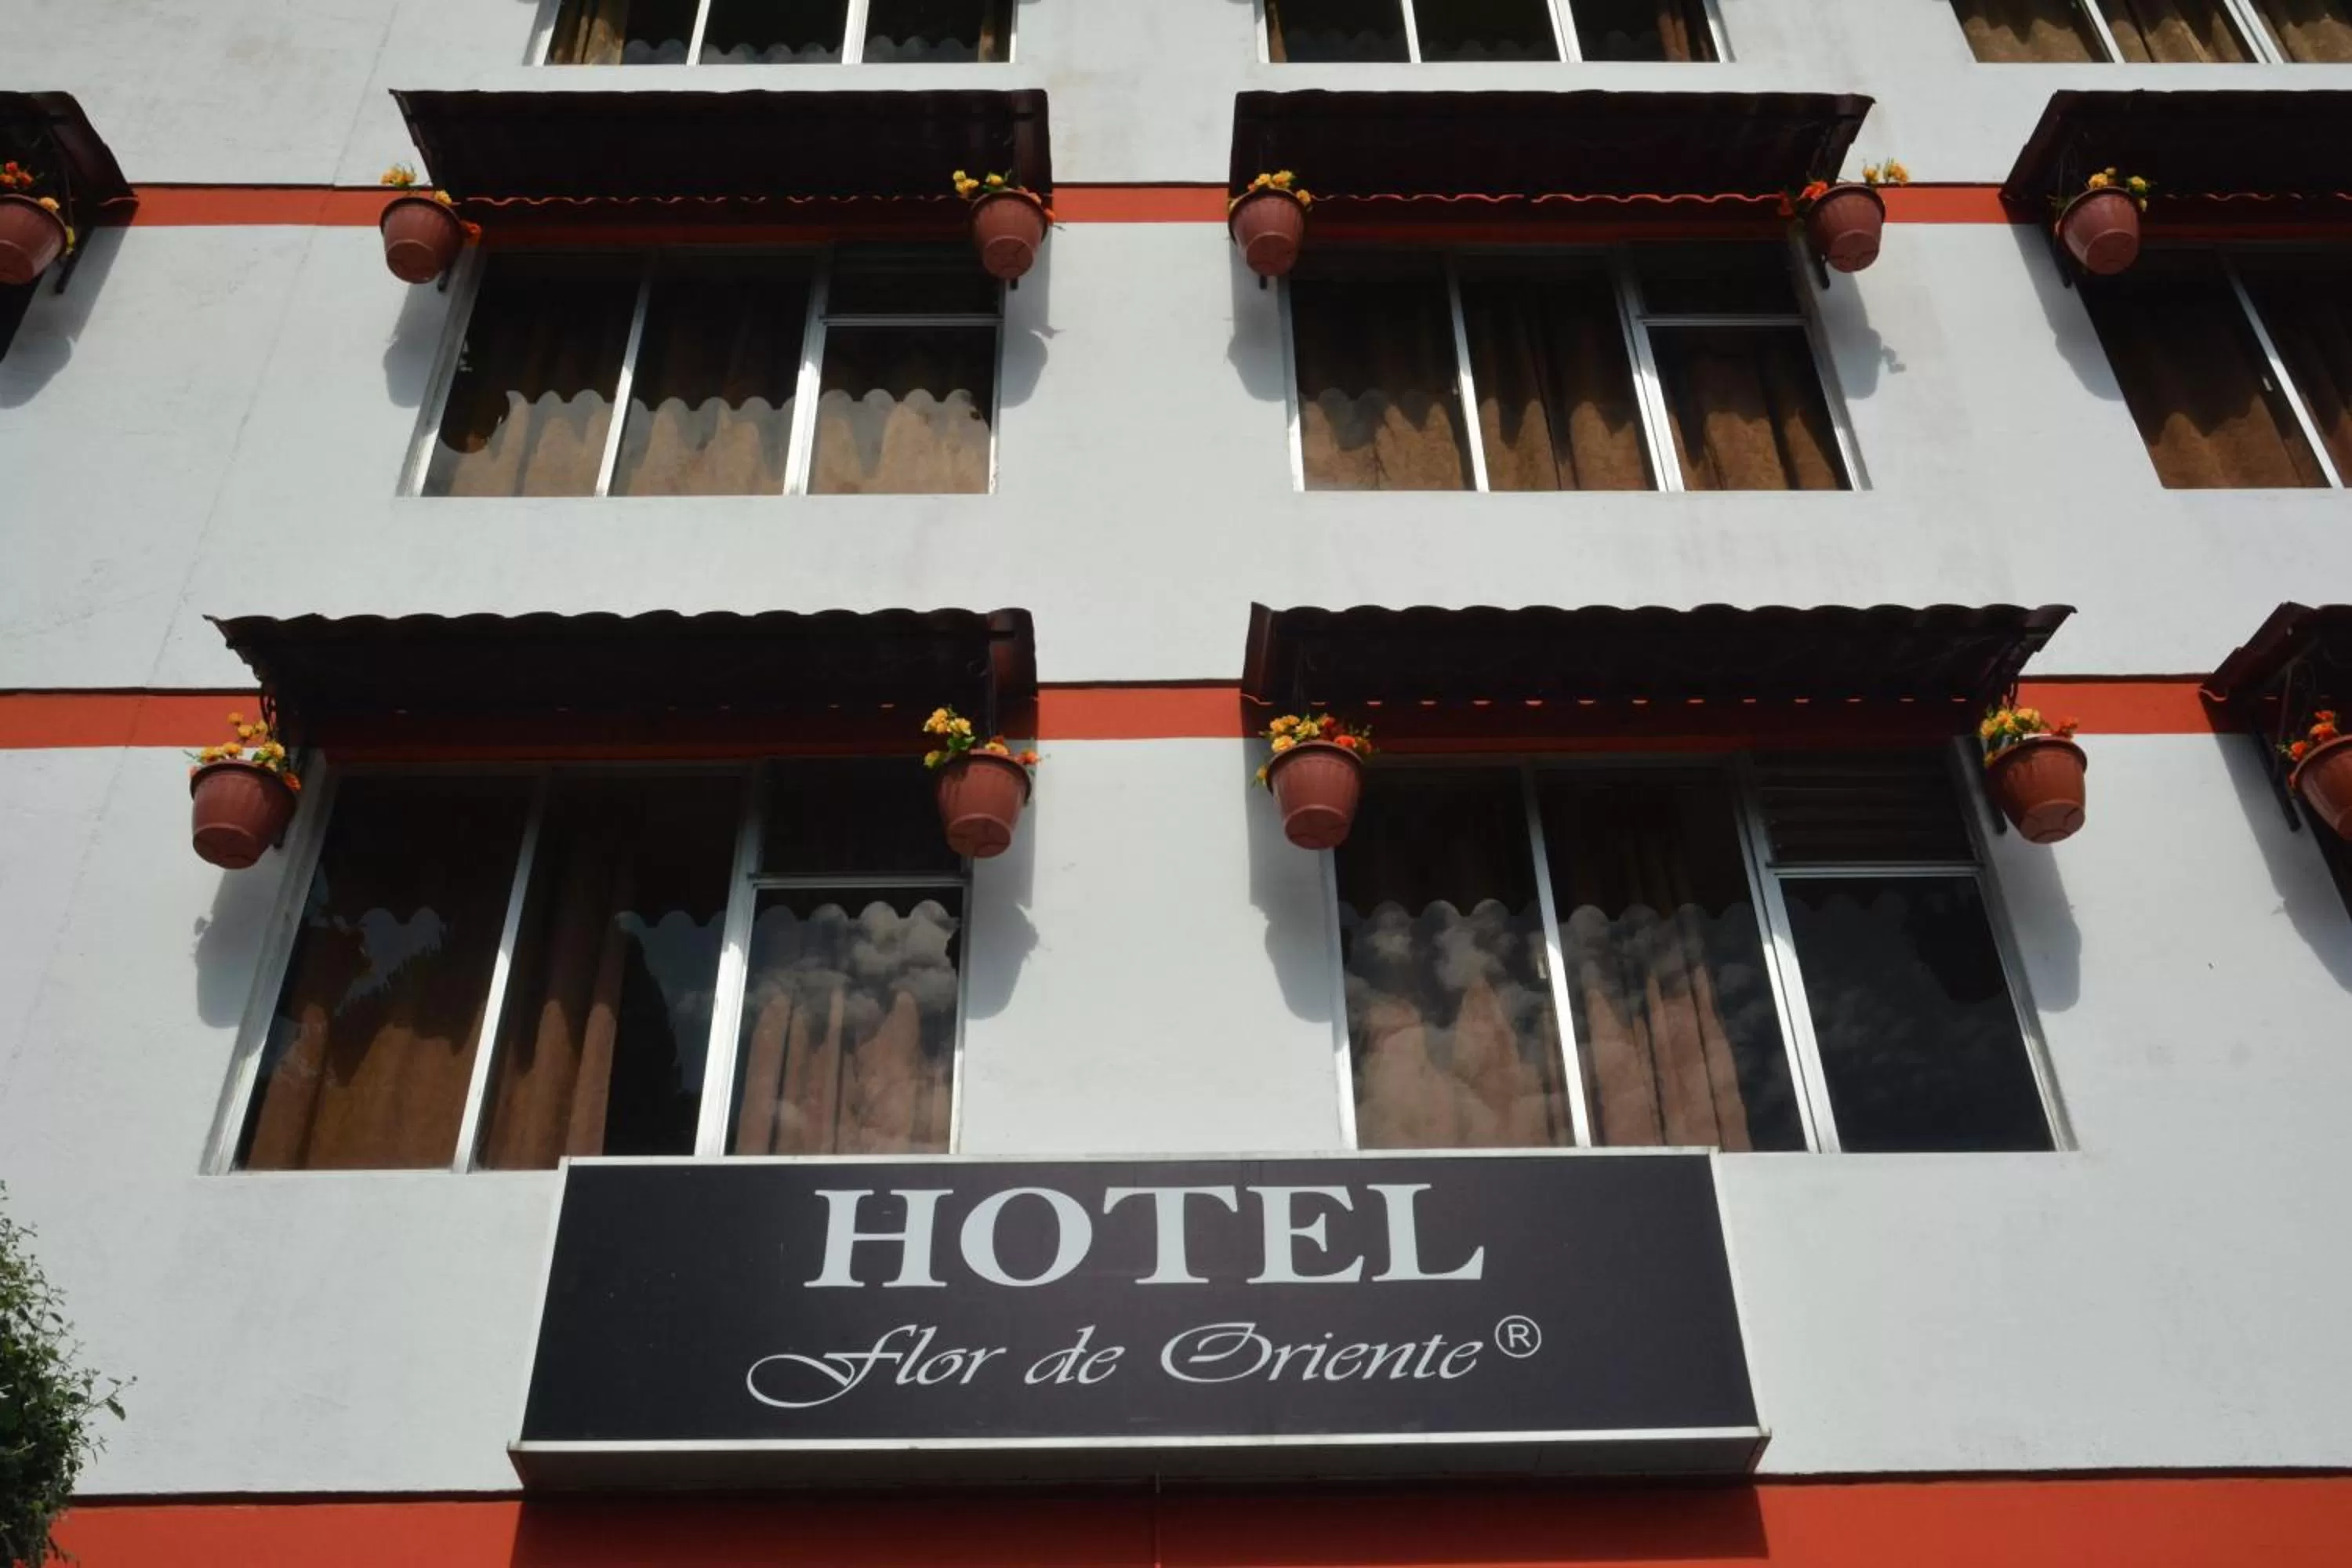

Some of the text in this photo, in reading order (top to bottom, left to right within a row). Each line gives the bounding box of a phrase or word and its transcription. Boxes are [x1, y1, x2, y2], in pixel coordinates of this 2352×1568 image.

[803, 1183, 1485, 1288] HOTEL
[746, 1324, 1007, 1408] Flor
[1024, 1324, 1126, 1385] de
